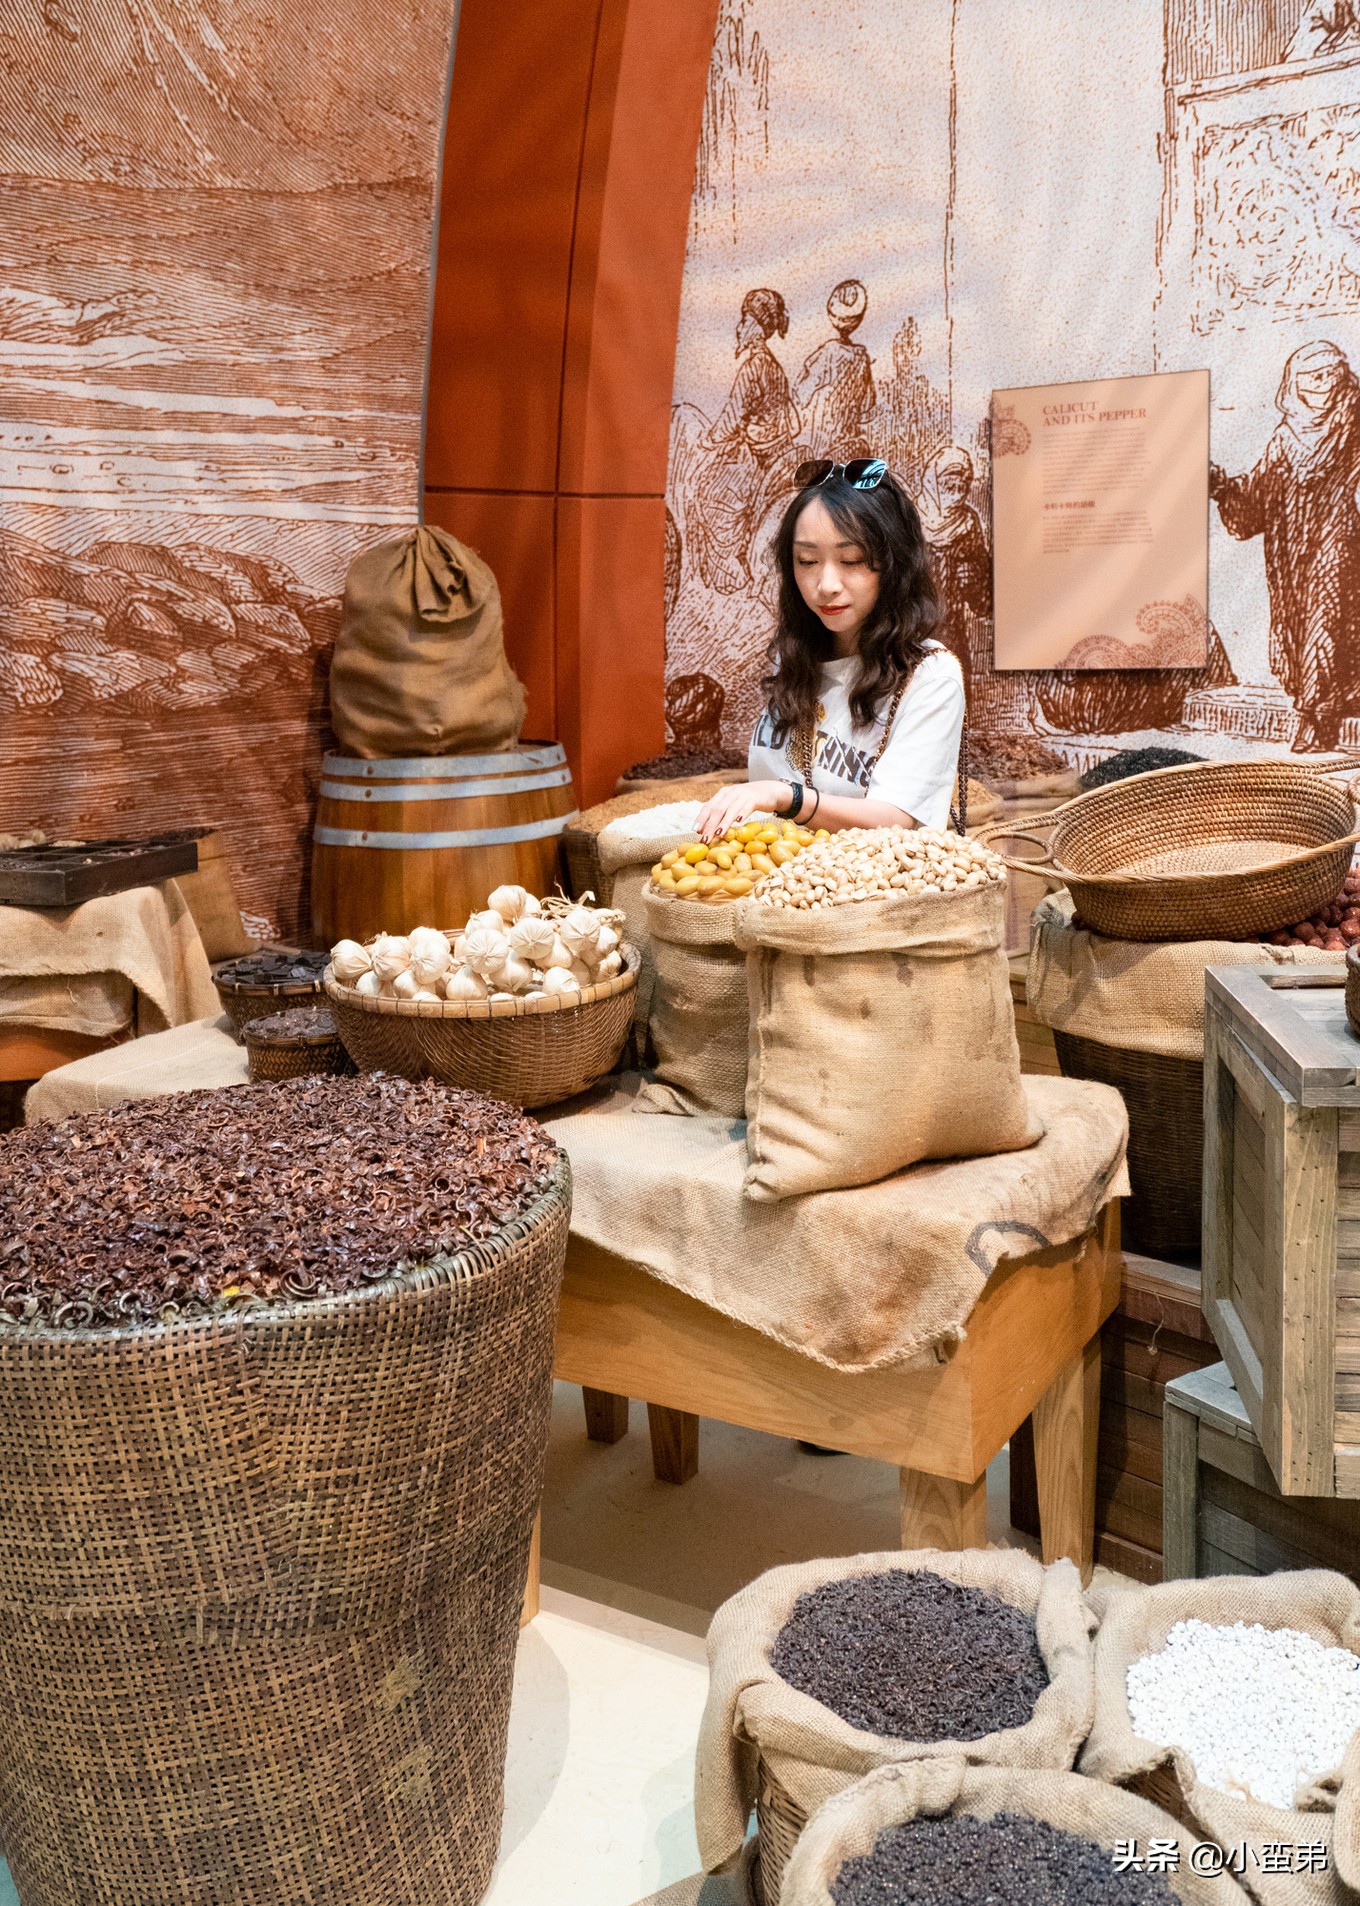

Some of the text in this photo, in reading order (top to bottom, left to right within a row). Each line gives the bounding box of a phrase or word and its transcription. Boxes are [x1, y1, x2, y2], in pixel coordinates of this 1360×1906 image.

[1043, 402, 1096, 415] CALICUT
[1043, 409, 1146, 426] AND ITS PEPPER
